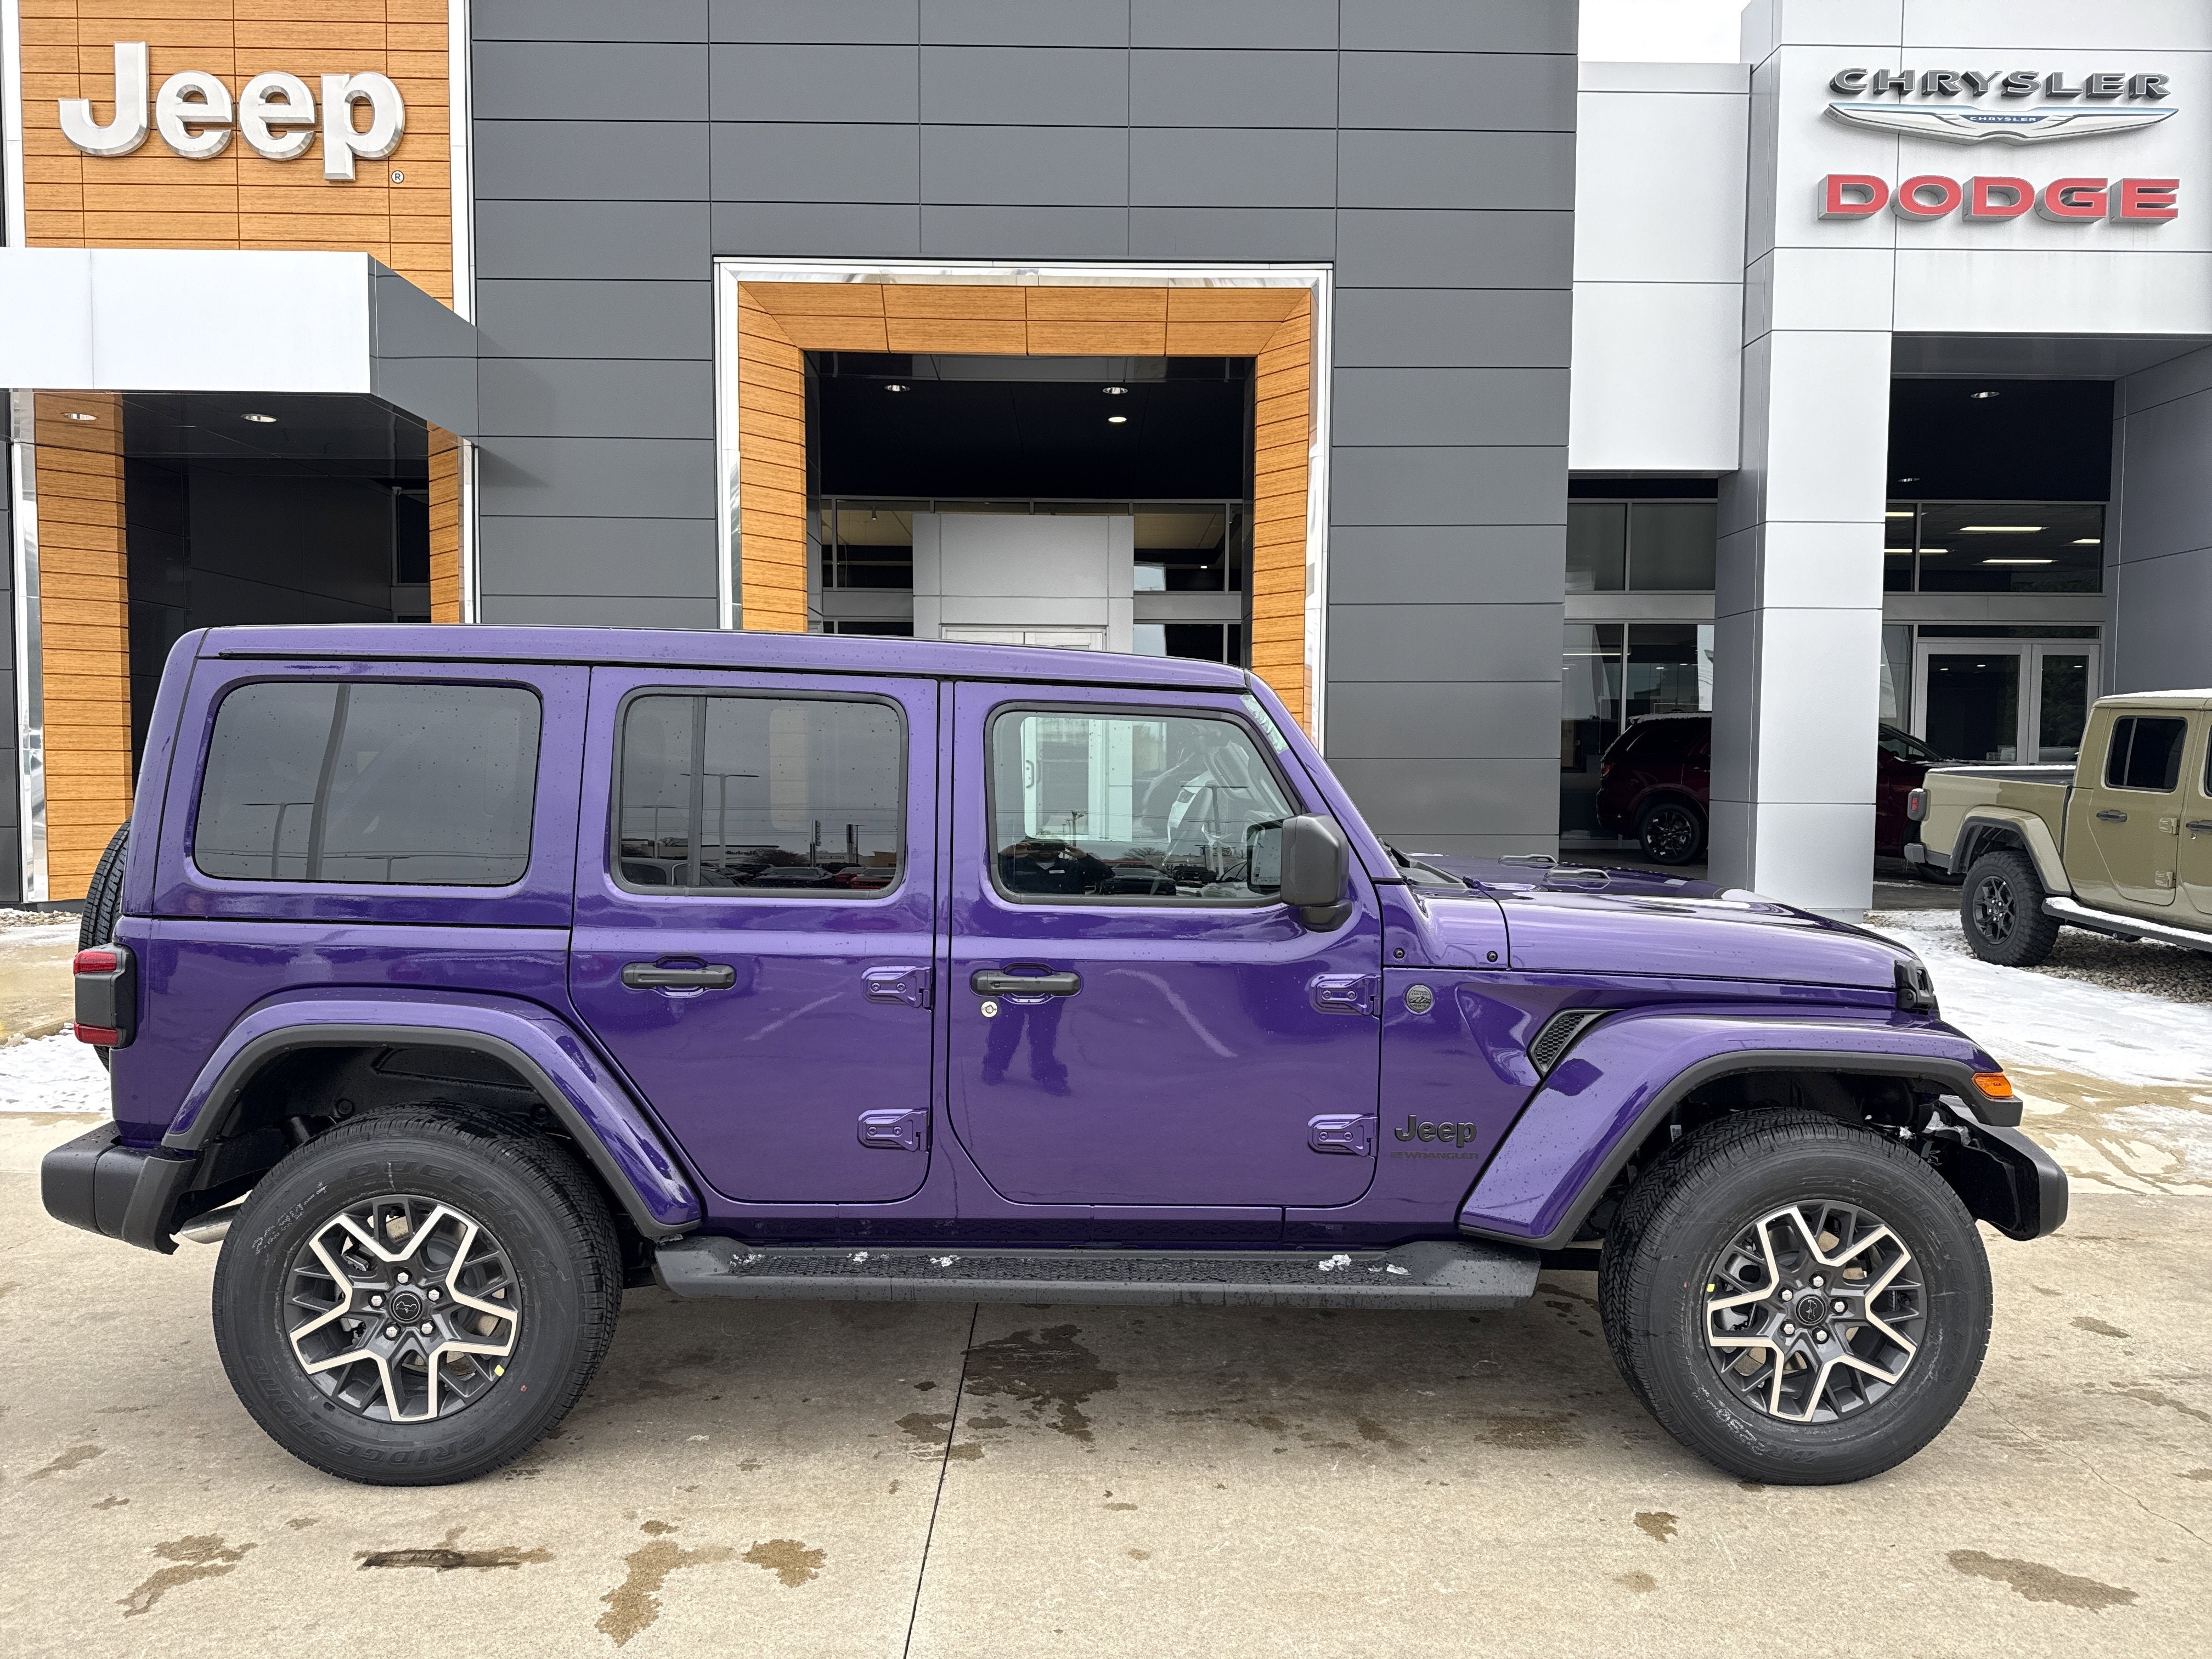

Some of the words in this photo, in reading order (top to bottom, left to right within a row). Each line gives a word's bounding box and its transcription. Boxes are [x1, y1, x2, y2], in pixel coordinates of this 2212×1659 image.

[1829, 68, 2170, 99] CHRYSLER
[59, 41, 405, 181] Jeep
[1818, 174, 2179, 223] DODGE
[1394, 1114, 1477, 1148] Jeep
[246, 1356, 486, 1466] BRIDGESTONE
